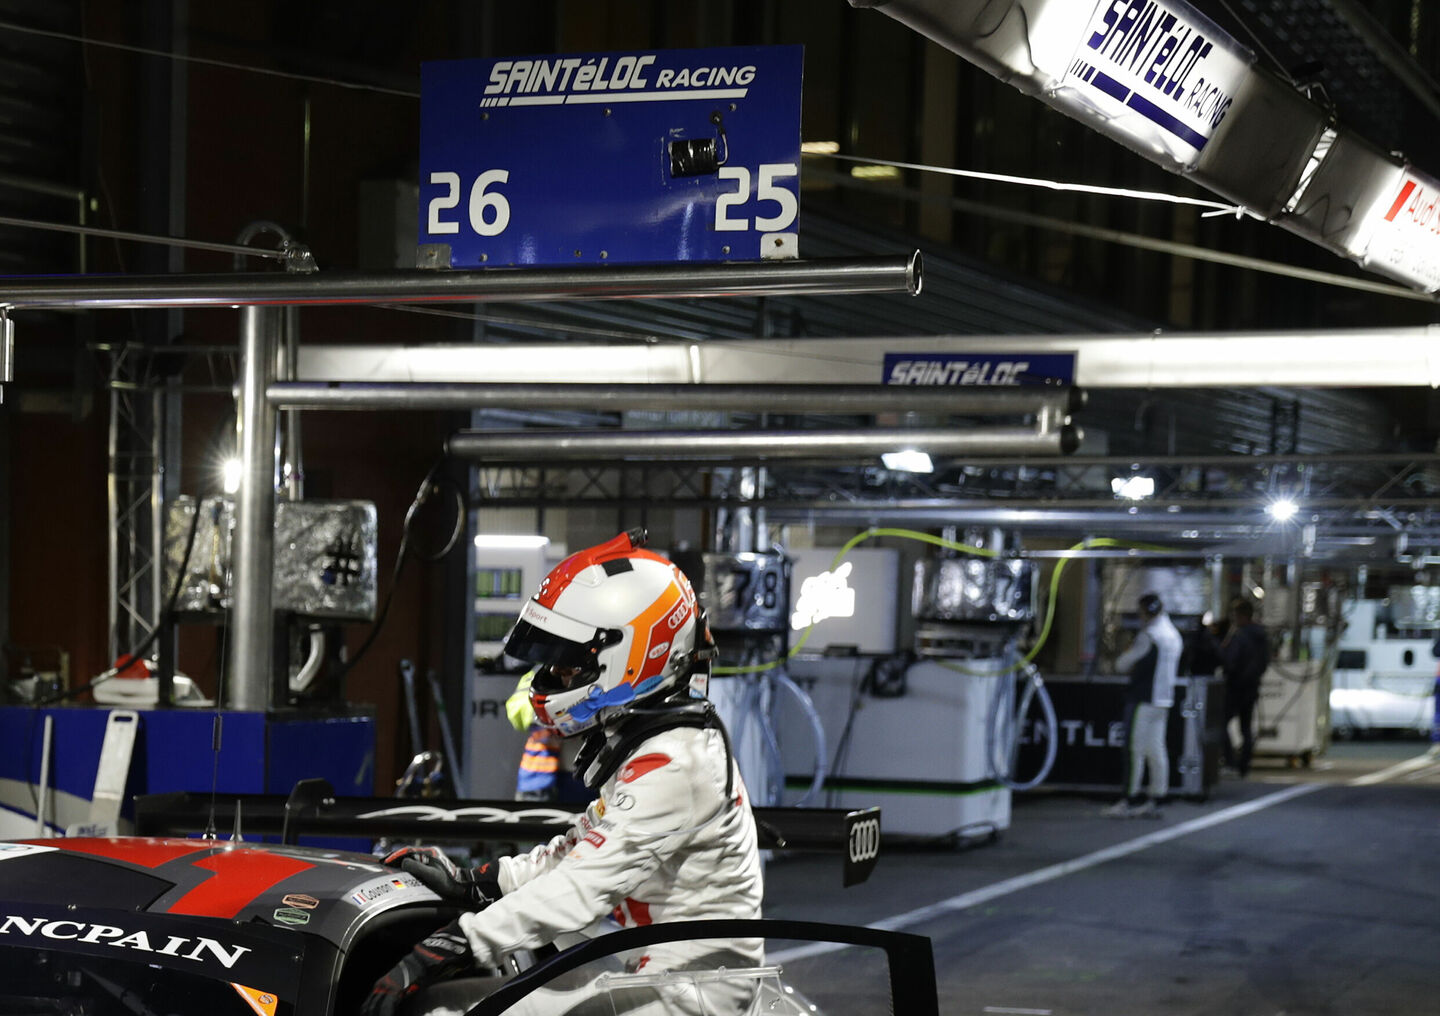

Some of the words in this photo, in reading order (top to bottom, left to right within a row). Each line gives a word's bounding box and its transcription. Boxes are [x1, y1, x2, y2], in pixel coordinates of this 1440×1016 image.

[656, 65, 756, 88] RACING
[1184, 78, 1233, 130] RACING
[428, 169, 510, 236] 26
[715, 164, 798, 231] 25
